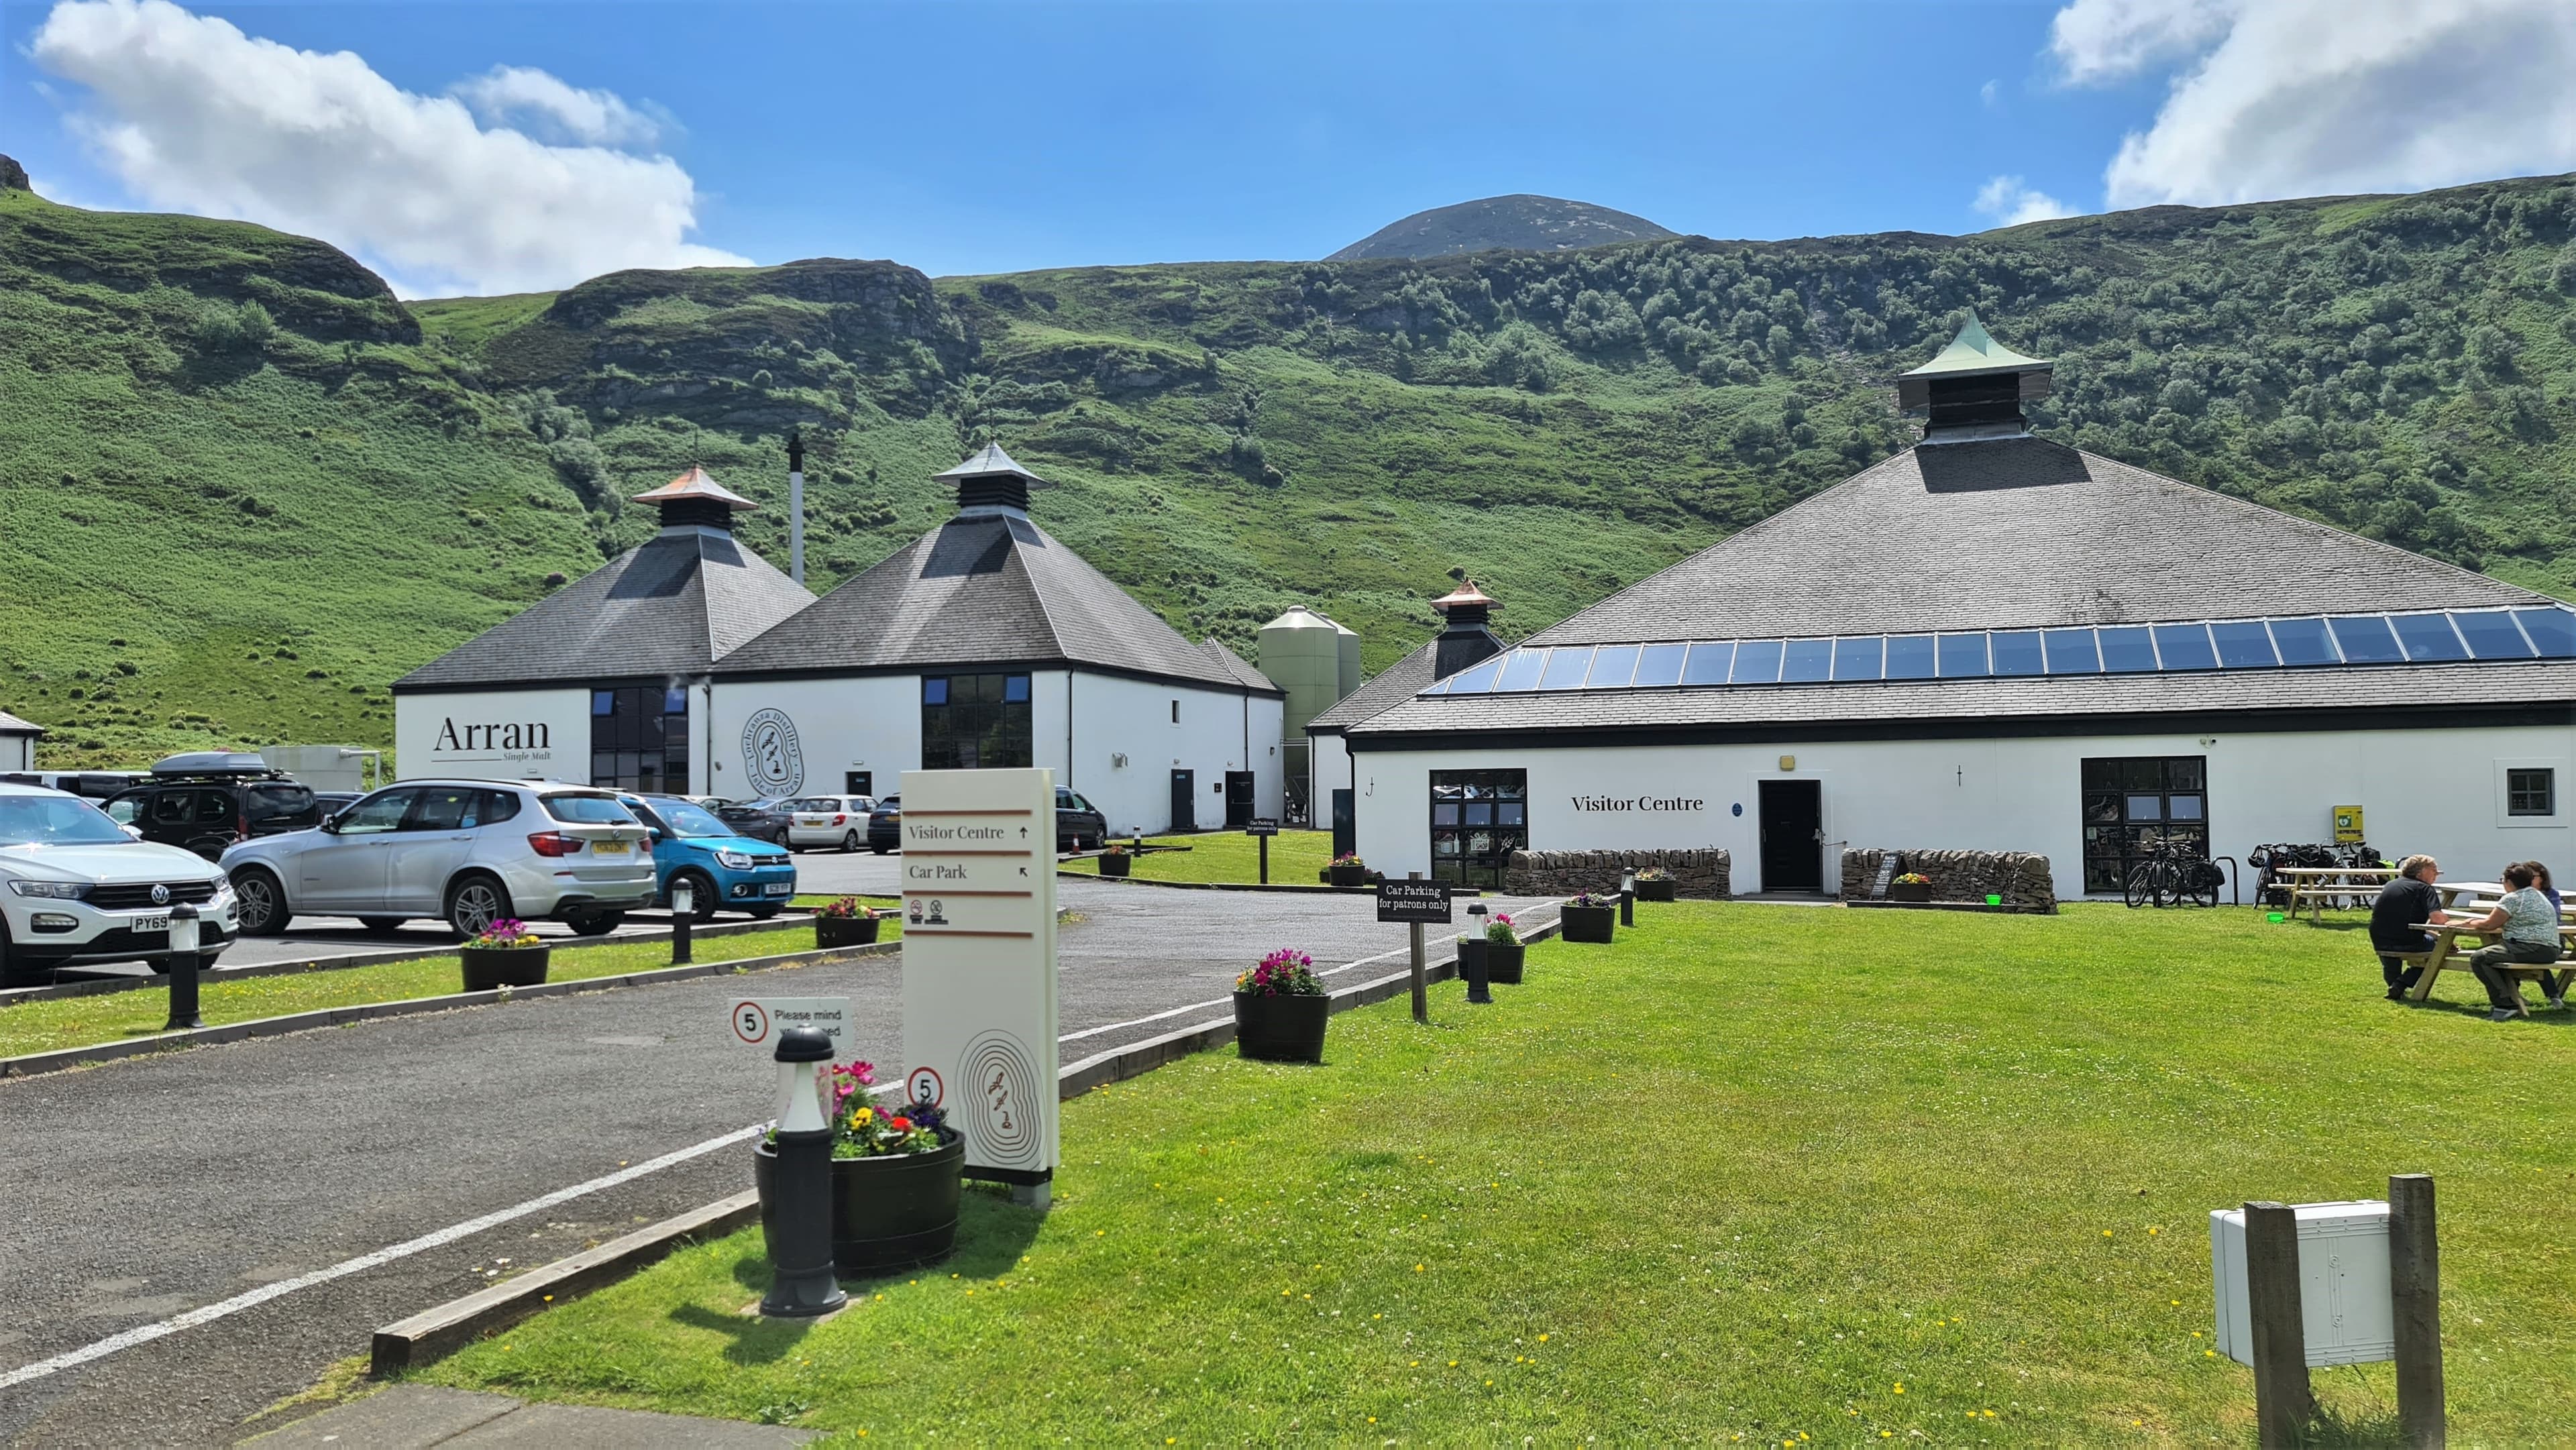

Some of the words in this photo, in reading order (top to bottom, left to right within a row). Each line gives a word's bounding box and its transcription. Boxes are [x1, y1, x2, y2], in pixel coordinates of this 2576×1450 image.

[433, 717, 551, 750] Arran
[744, 713, 770, 760] Lochranza
[773, 713, 799, 759] Distillery
[504, 752, 529, 763] Single
[531, 752, 551, 761] Malt
[751, 773, 765, 790] Isle
[766, 787, 777, 795] of
[779, 773, 800, 795] Arran
[1571, 795, 1634, 812] Visitor
[1639, 796, 1704, 811] Centre
[909, 826, 954, 839] Visitor
[957, 826, 1004, 839] Centre
[910, 865, 933, 879] Car
[936, 864, 967, 879] Park
[1386, 885, 1402, 895] Car
[1404, 886, 1441, 898] Parking
[1379, 898, 1391, 907] for
[1393, 899, 1426, 910] patrons
[1429, 899, 1448, 911] only
[745, 1013, 756, 1031] 5
[774, 1009, 811, 1020] Please
[814, 1009, 842, 1020] mind
[920, 1079, 931, 1099] 5
